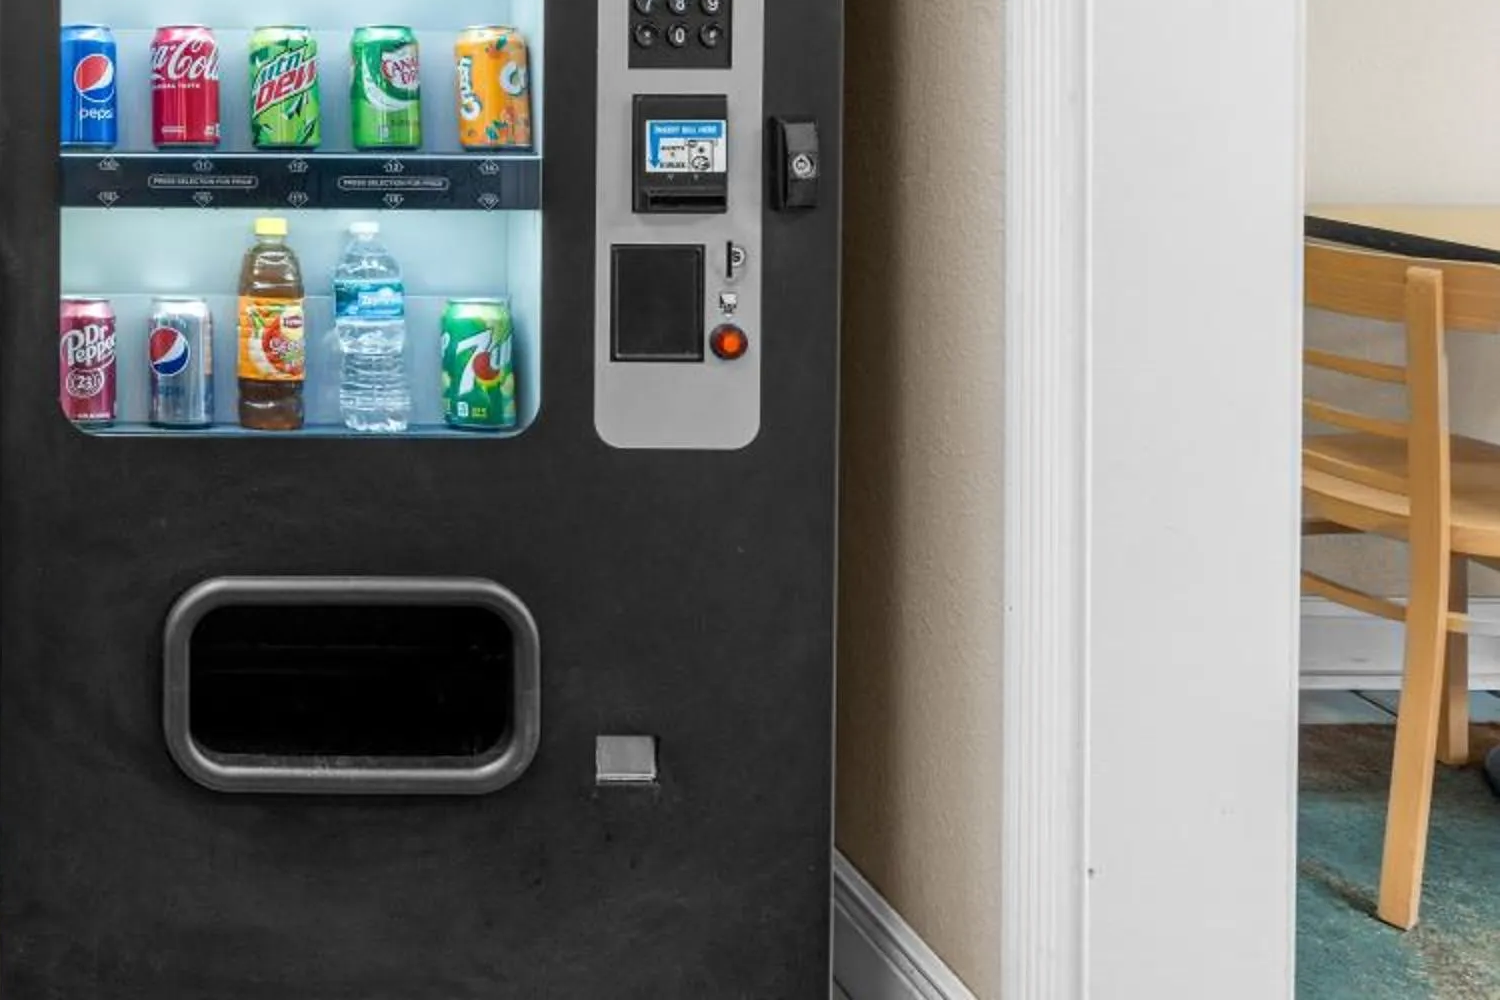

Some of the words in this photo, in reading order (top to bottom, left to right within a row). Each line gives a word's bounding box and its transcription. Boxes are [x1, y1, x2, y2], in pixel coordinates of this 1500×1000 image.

[675, 28, 685, 43] 0
[79, 107, 114, 121] peps
[83, 323, 109, 347] Dr
[60, 329, 115, 367] Peppe
[455, 329, 513, 396] 7U
